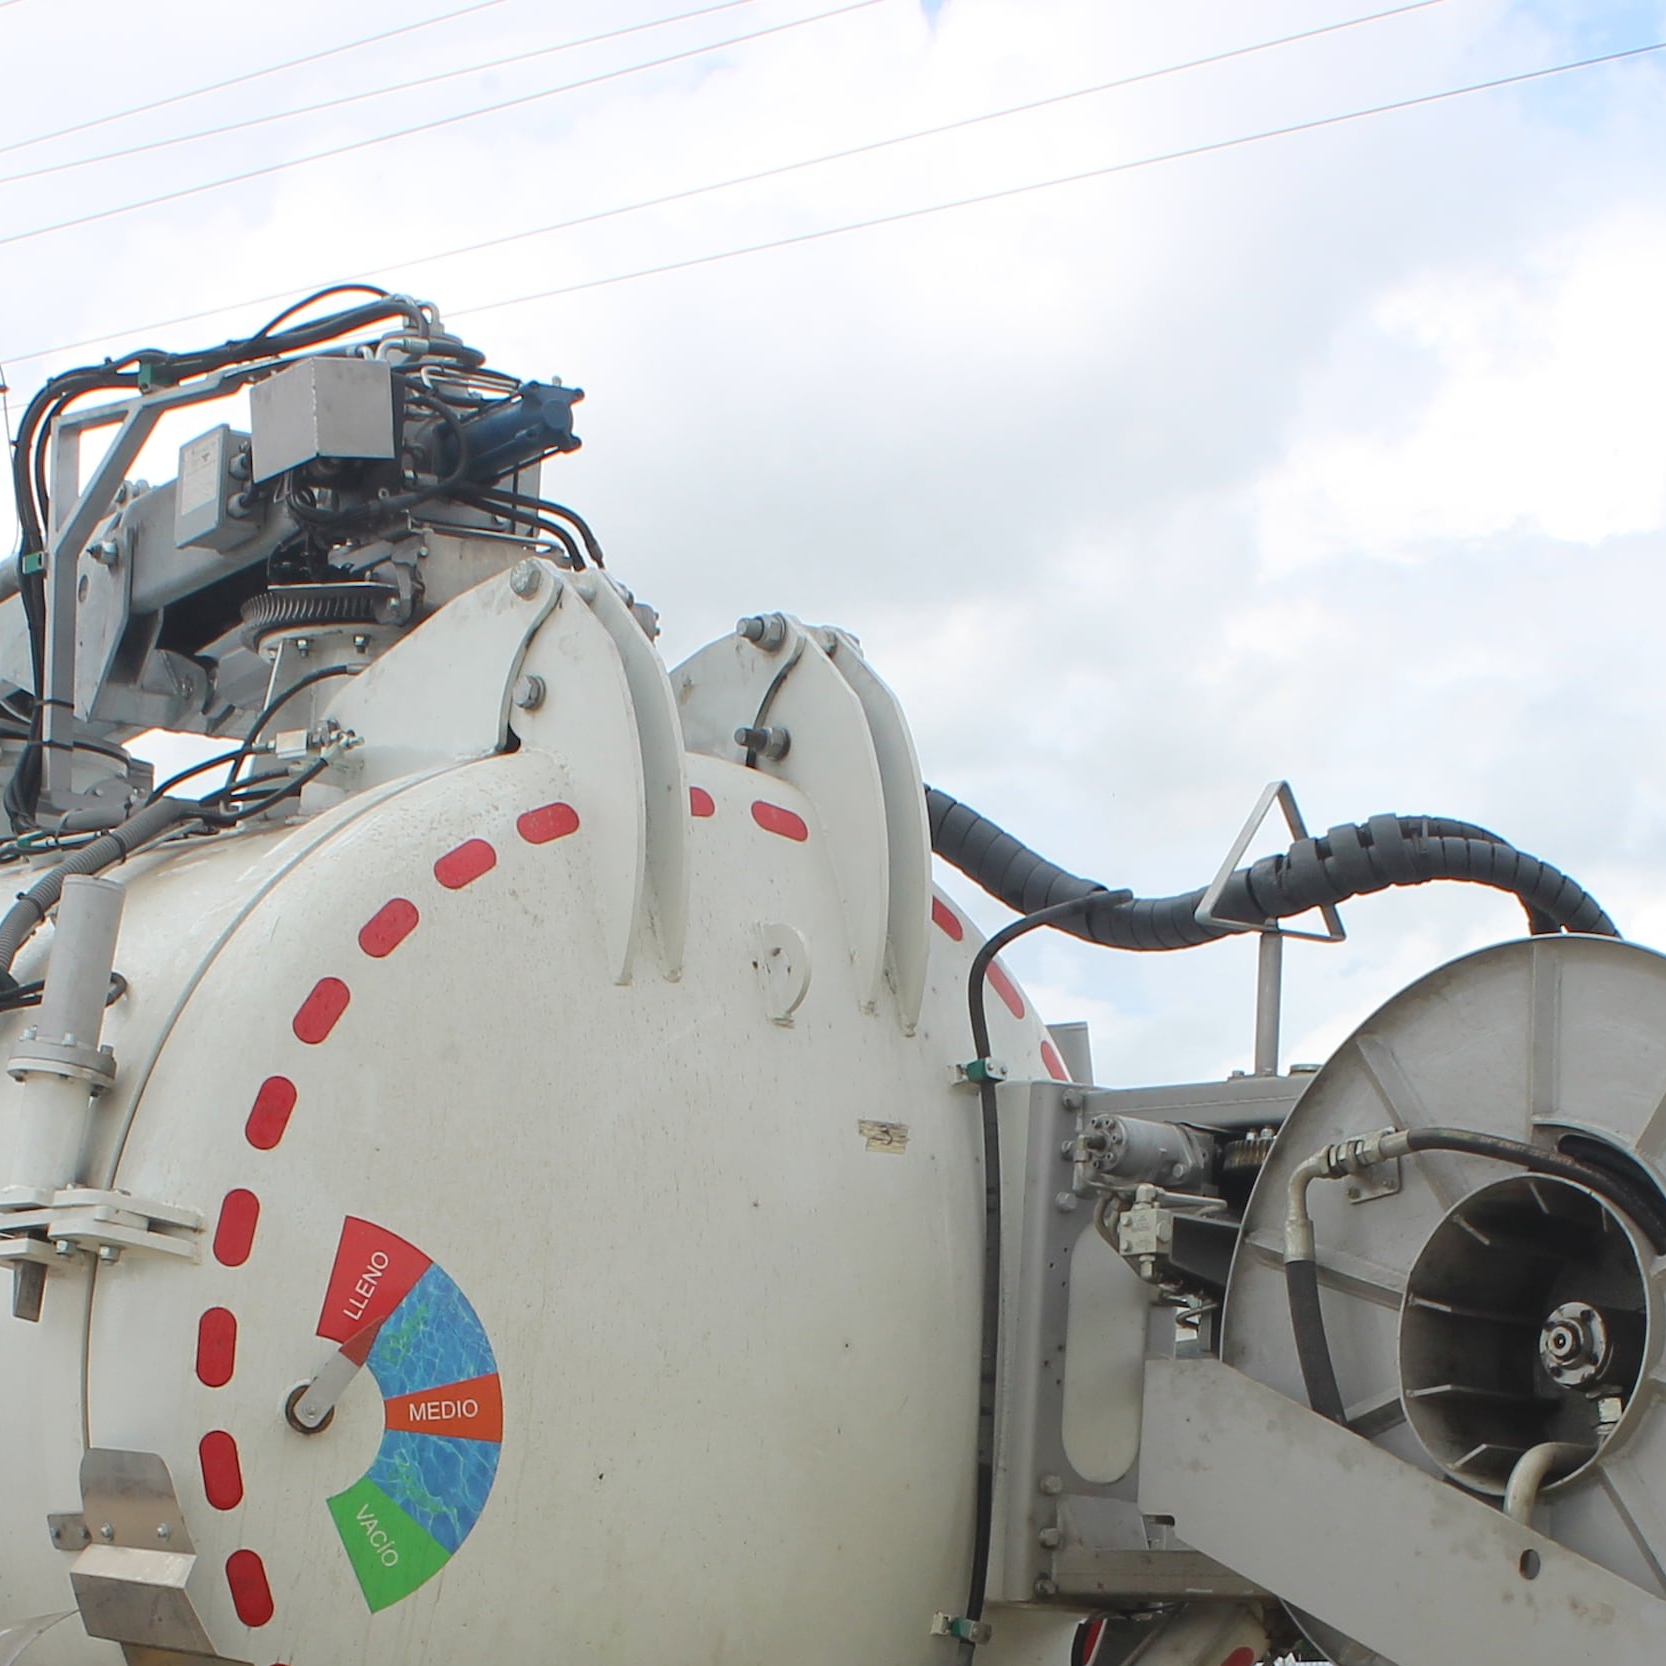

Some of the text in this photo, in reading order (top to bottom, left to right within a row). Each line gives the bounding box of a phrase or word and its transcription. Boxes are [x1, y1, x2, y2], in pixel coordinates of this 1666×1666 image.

[342, 1249, 390, 1322] LLENO
[408, 1398, 479, 1422] MEDIO
[354, 1503, 400, 1568] VACÍO
